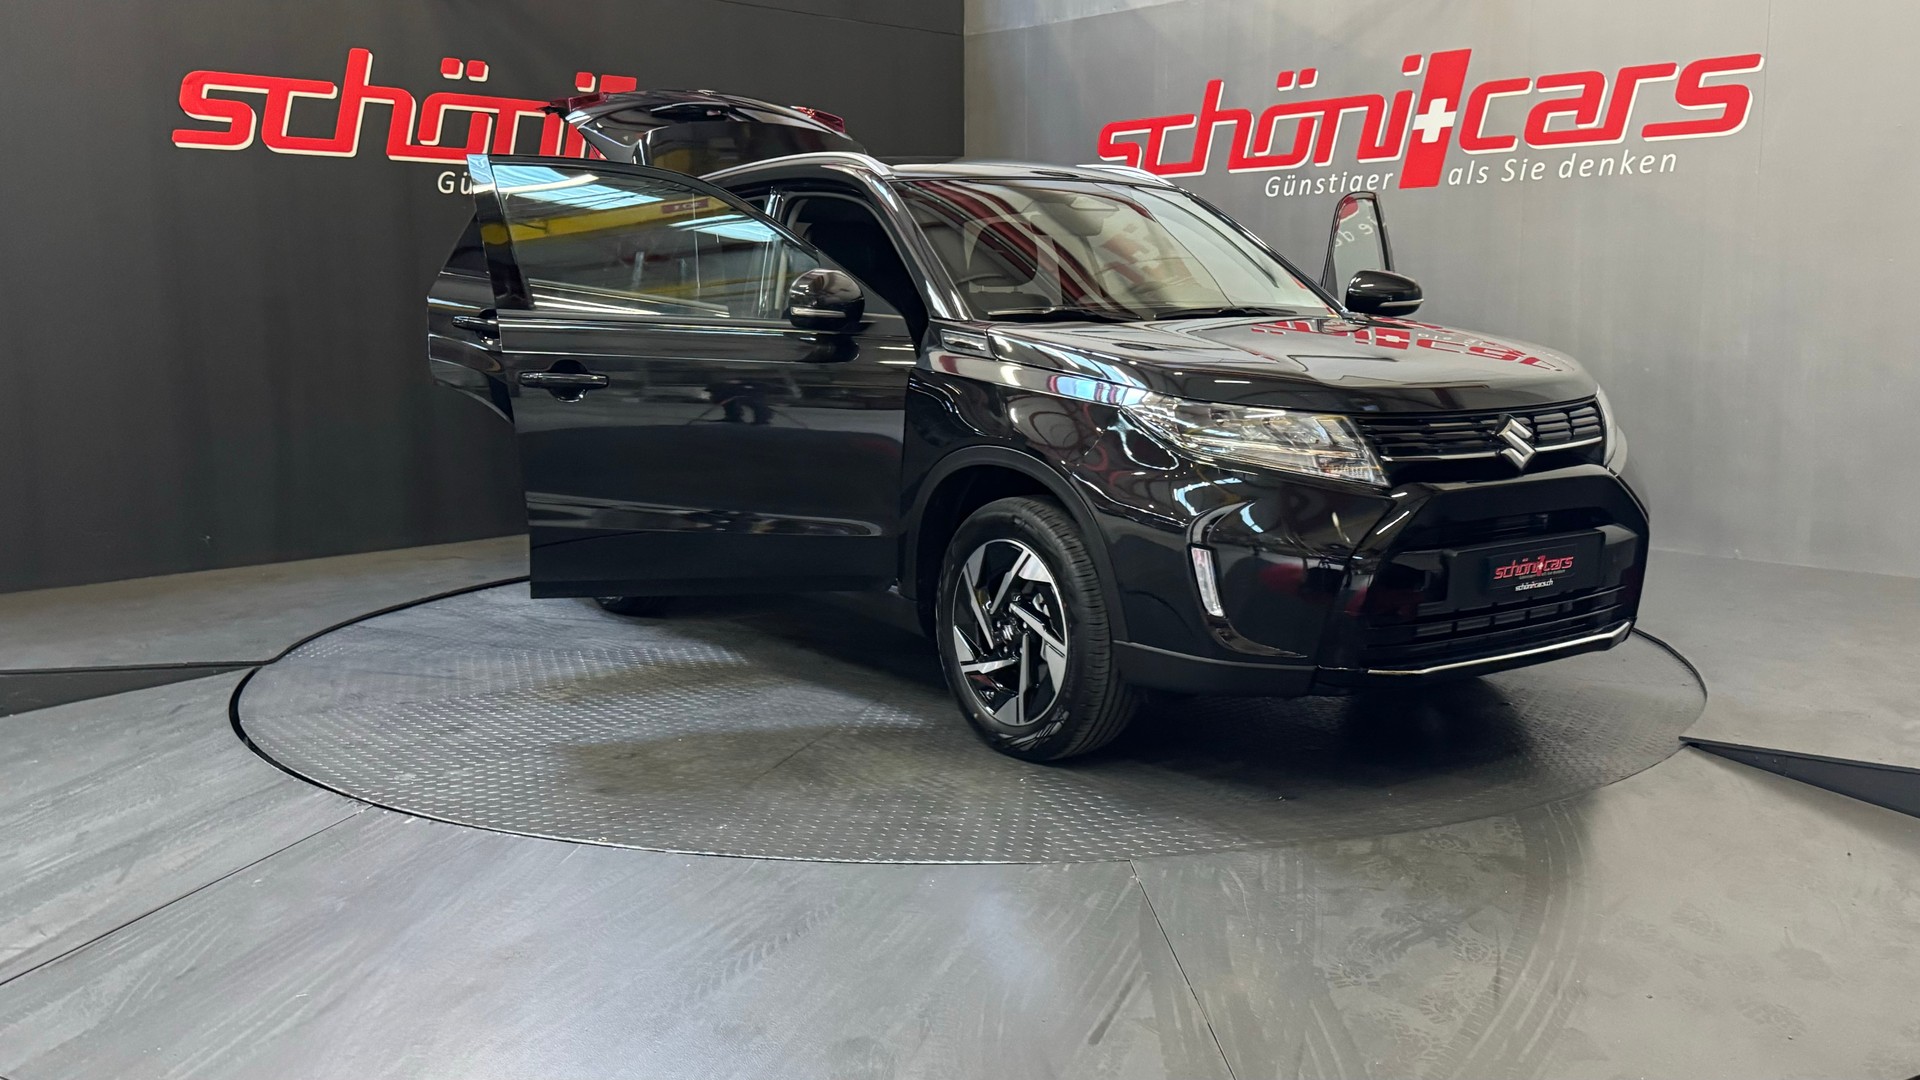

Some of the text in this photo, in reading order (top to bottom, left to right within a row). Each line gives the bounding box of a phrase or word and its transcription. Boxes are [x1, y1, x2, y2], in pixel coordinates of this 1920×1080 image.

[1448, 160, 1490, 186] als
[1501, 158, 1547, 183] Sie
[1557, 149, 1678, 179] denken
